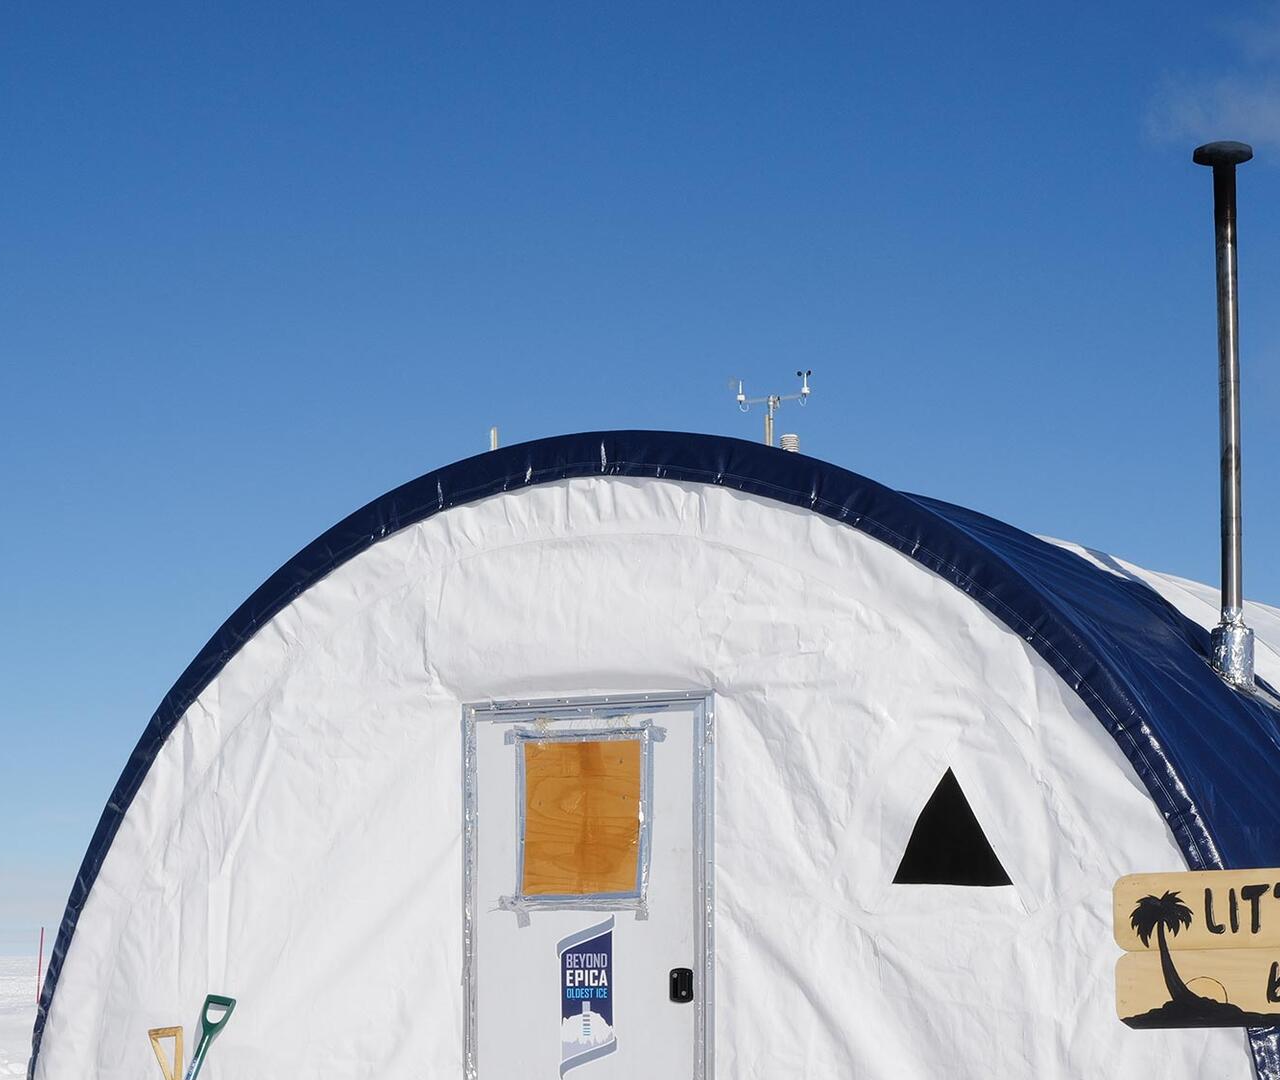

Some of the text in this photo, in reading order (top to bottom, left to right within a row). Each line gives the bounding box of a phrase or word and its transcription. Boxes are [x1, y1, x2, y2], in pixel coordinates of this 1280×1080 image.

[566, 953, 608, 969] BEYOND
[566, 969, 608, 987] EPICA
[566, 987, 608, 999] OLDEST ICE
